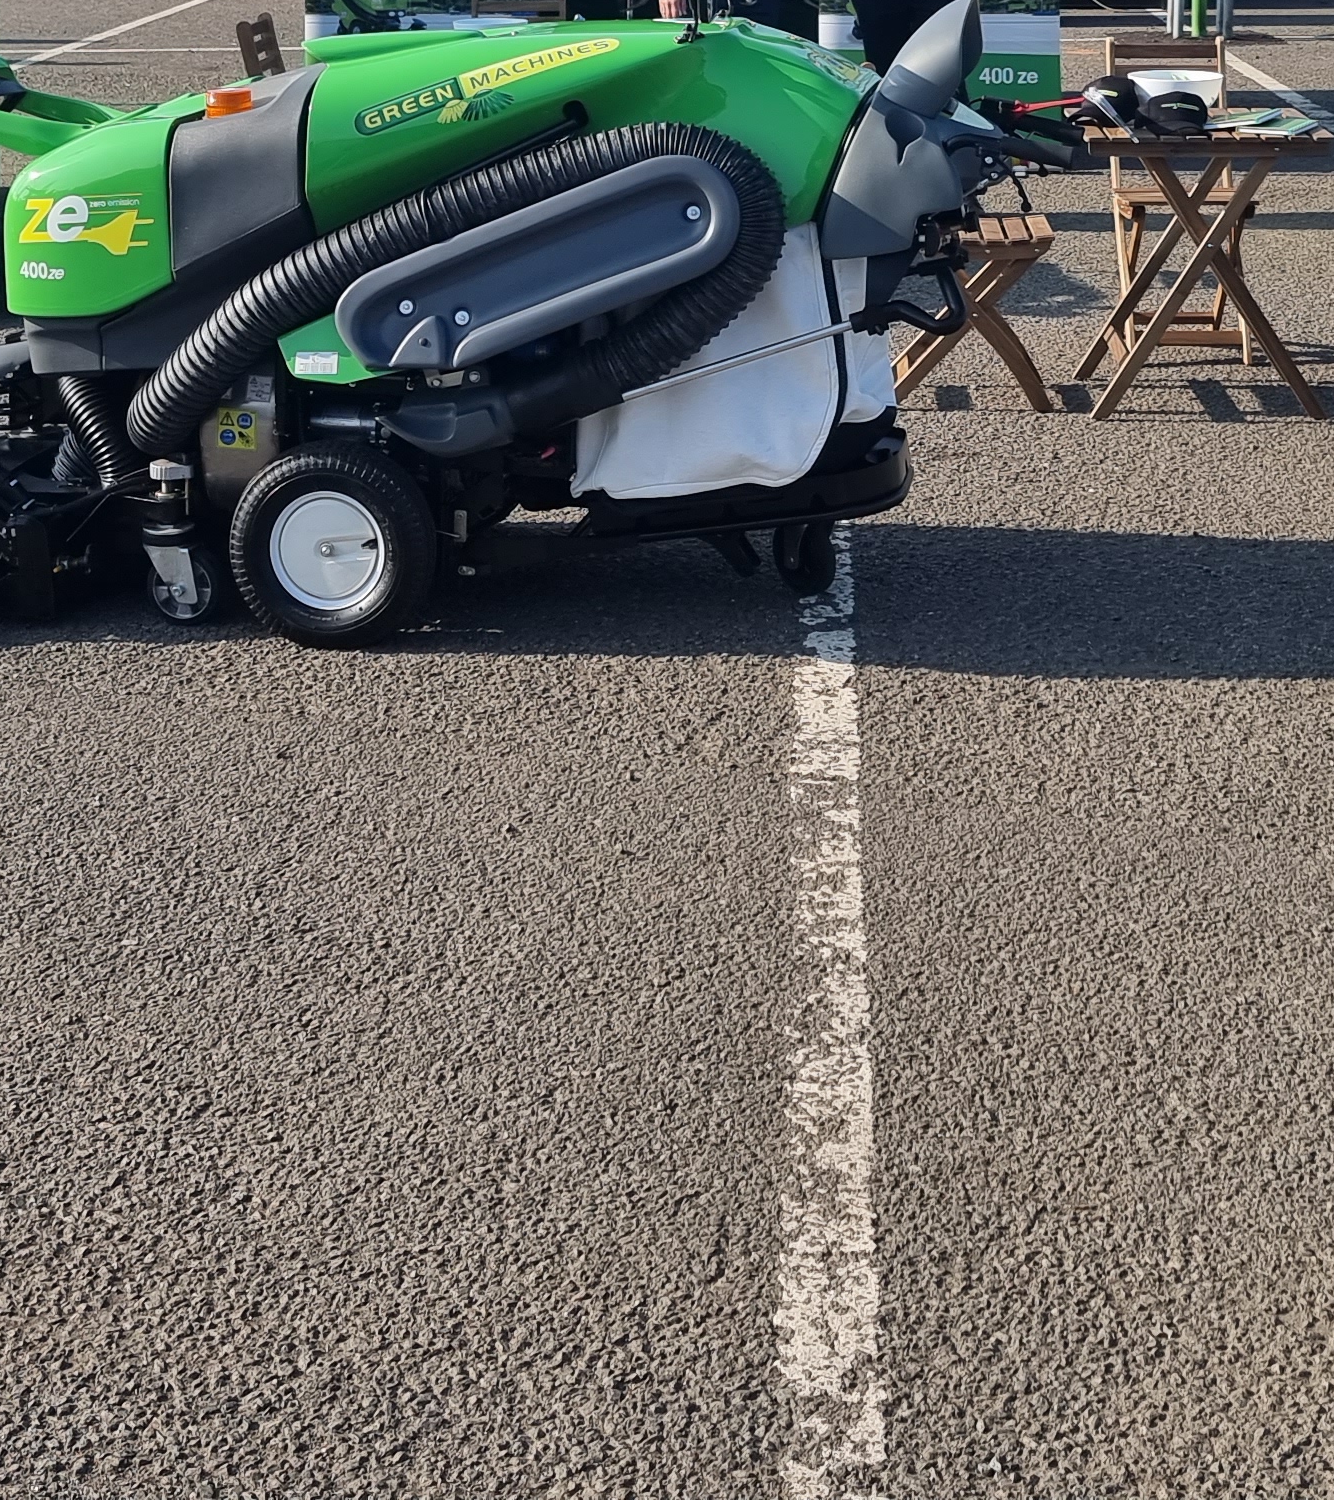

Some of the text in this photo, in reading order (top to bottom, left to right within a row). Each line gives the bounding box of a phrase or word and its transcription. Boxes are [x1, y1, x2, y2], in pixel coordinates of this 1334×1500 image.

[363, 39, 611, 130] GREEN MACHINES
[977, 66, 1040, 85] 400 ze
[89, 198, 141, 208] zero emission
[19, 260, 66, 281] 400ze
